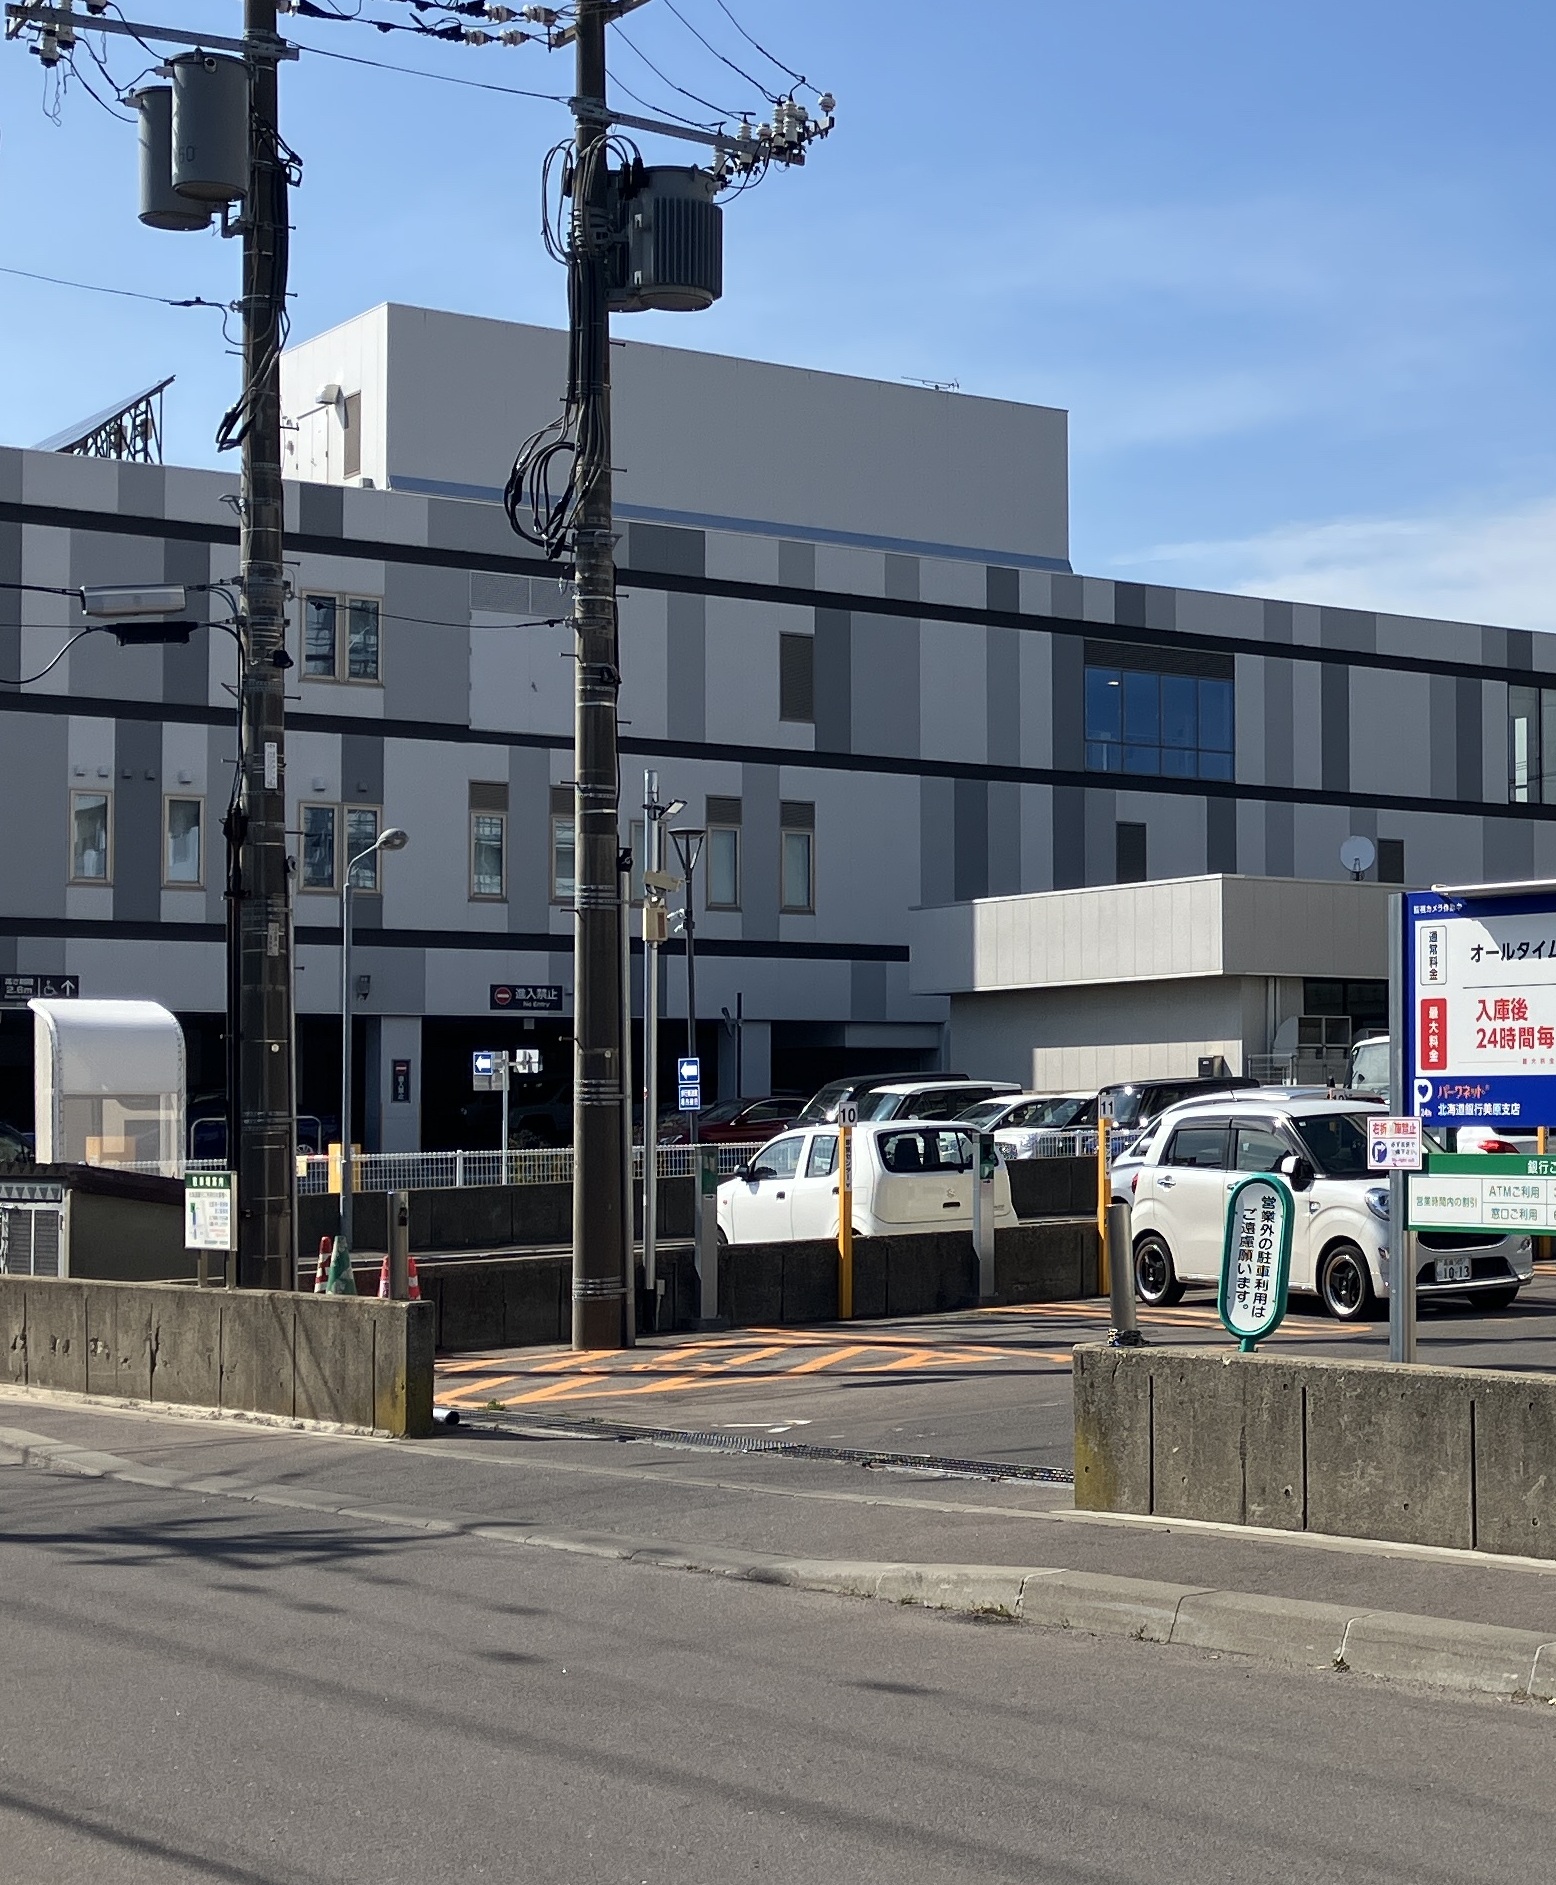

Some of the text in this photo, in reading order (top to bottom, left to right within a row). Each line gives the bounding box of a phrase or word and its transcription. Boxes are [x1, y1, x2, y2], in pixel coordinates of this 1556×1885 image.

[1428, 930, 1438, 981] 通常料金
[515, 988, 559, 1000] 進入禁止
[1476, 998, 1528, 1023] 入庫後
[1428, 1006, 1439, 1063] 最大料金
[1476, 1026, 1555, 1050] 24時間毎
[840, 1107, 856, 1123] 10
[1101, 1101, 1113, 1115] 11
[1437, 1102, 1521, 1117] 北海道銀行美原支店
[1372, 1122, 1417, 1135] 右折庫禁止
[1488, 1186, 1540, 1199] ATMご利用
[1416, 1196, 1478, 1208] 営業時間内の割引
[1491, 1208, 1538, 1221] 窓口ご利用
[1235, 1208, 1258, 1310] ご遠慮願います。
[1251, 1195, 1277, 1318] 営業外の駐車利用は
[1443, 1266, 1470, 1280] 10-13
